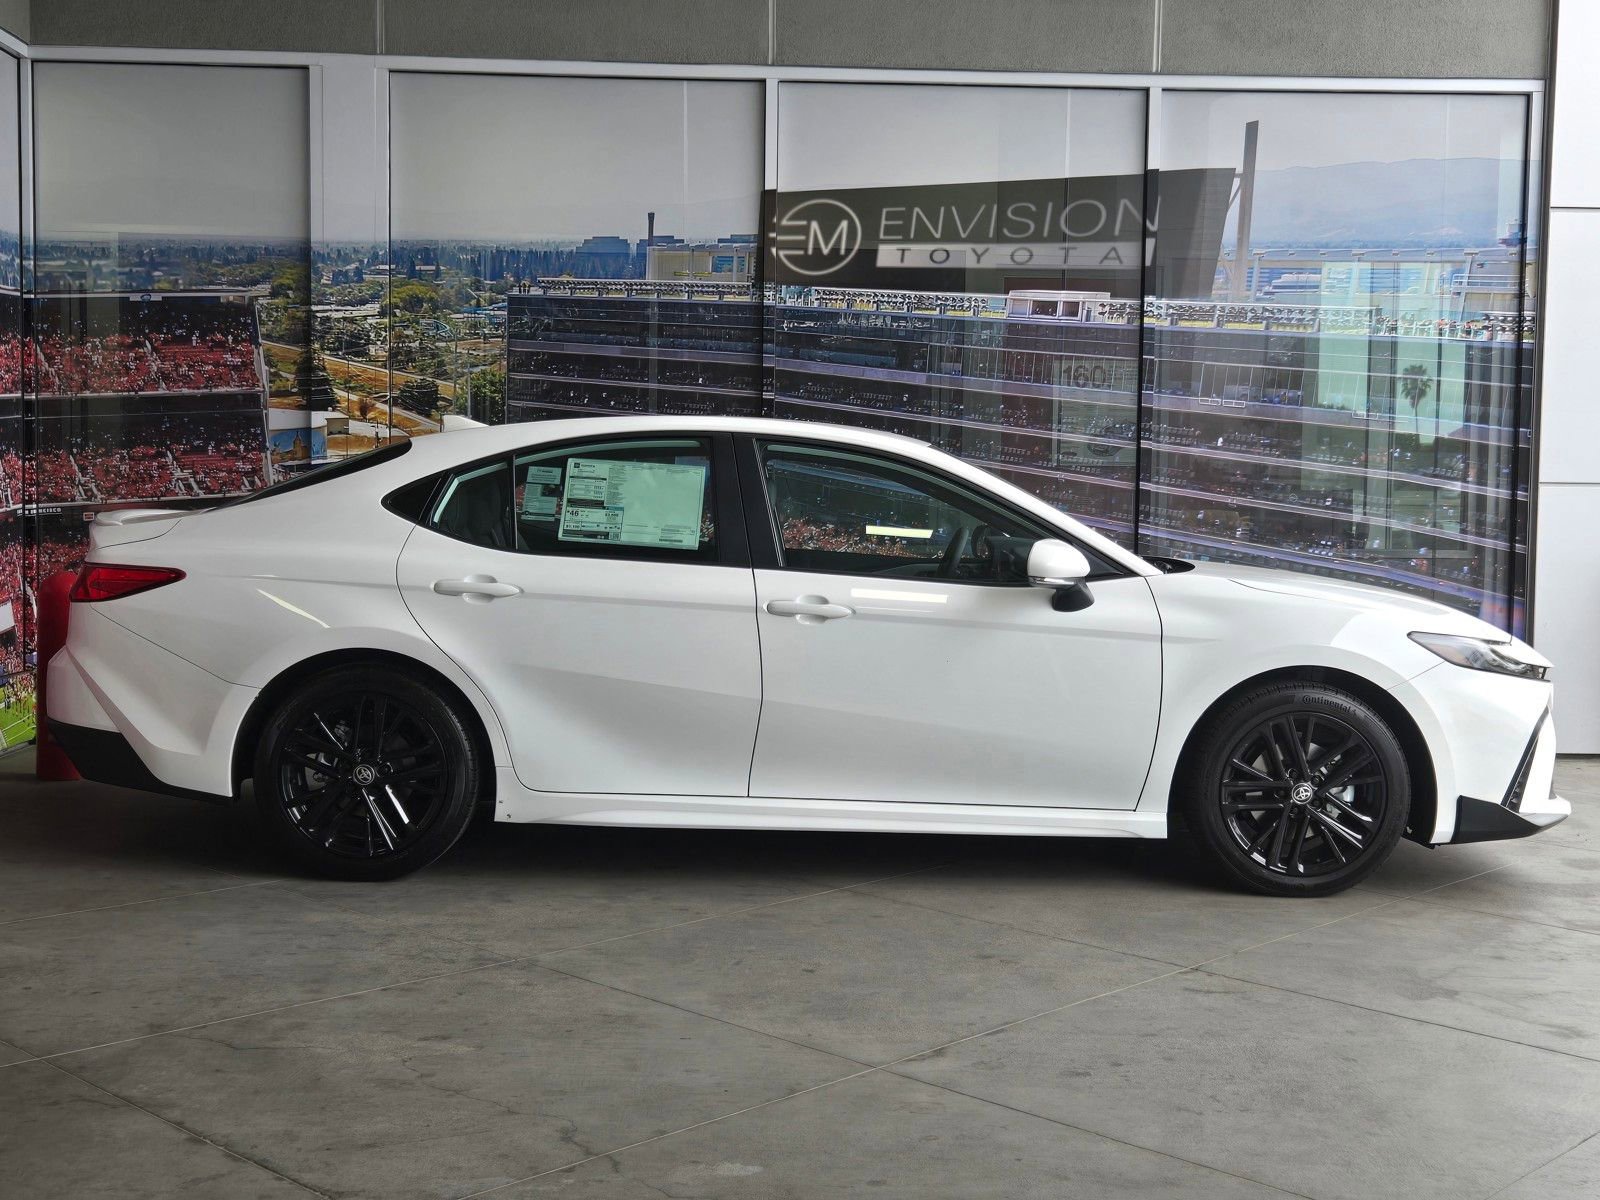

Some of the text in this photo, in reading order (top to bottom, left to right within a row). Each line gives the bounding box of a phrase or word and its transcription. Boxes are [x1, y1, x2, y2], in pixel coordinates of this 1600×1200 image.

[879, 197, 1160, 240] ENVISION
[896, 246, 1124, 265] TOYOTA
[1302, 695, 1351, 713] Continental
